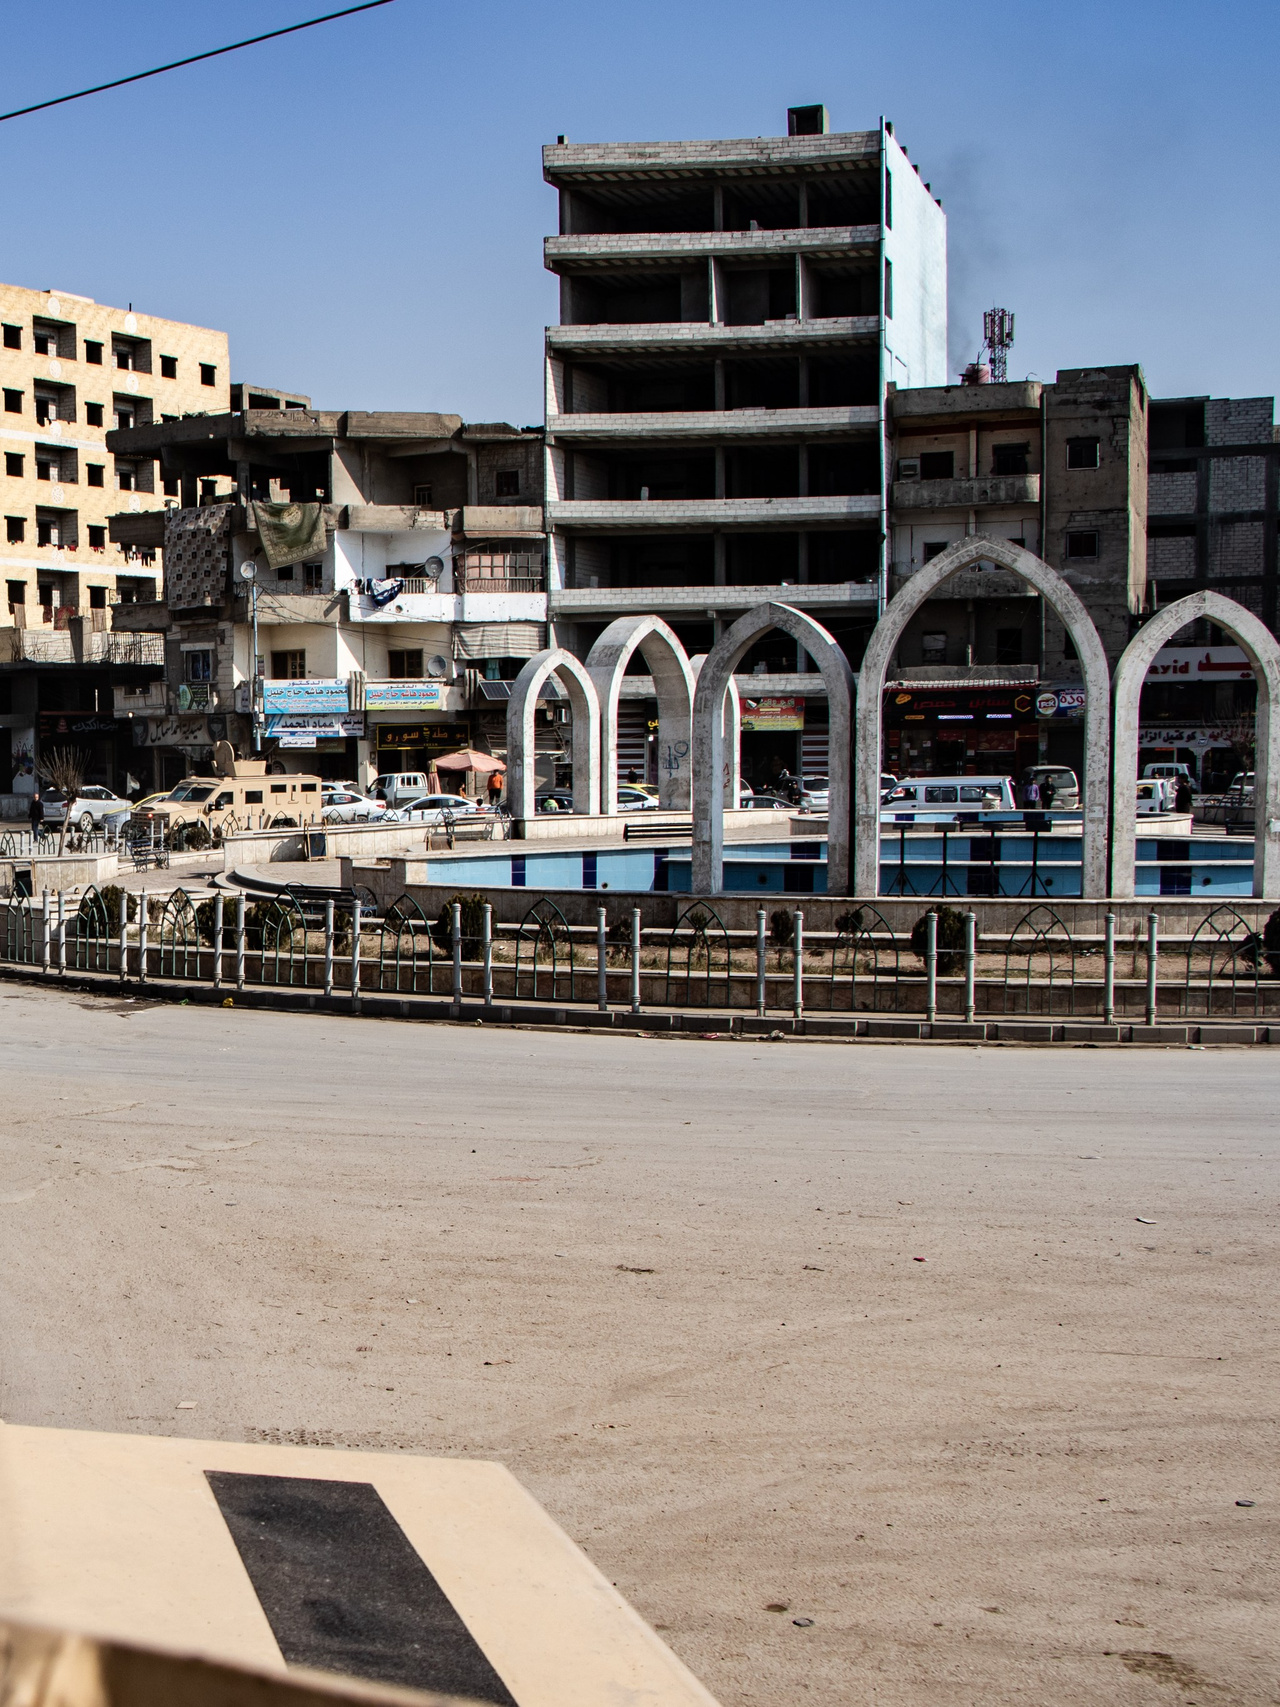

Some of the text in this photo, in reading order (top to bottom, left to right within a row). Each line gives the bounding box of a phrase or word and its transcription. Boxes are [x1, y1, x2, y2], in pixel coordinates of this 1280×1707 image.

[1148, 659, 1190, 675] ayid
[267, 687, 348, 698] محمود هاشم حاج خليل
[369, 690, 437, 700] محمود هاشم حاج خليل
[1060, 692, 1084, 706] ودة
[281, 718, 335, 729] عماد المحمد
